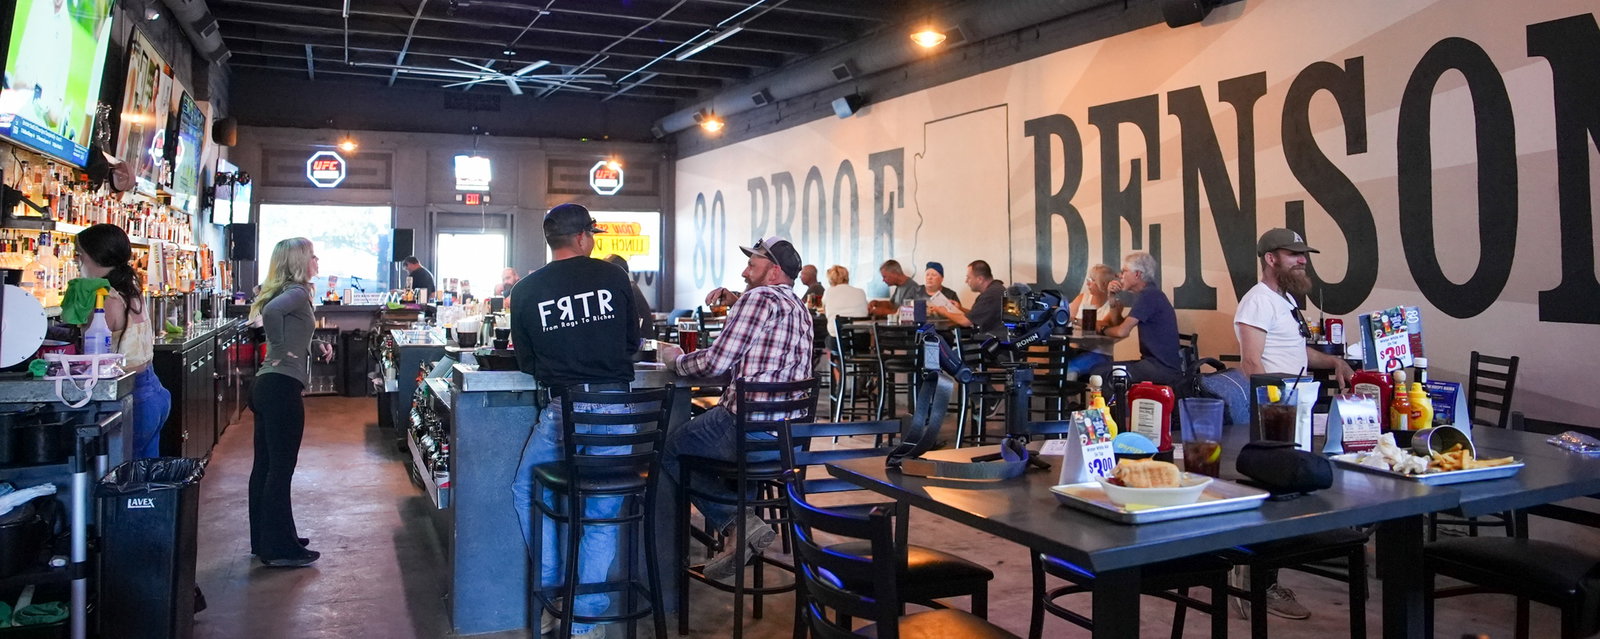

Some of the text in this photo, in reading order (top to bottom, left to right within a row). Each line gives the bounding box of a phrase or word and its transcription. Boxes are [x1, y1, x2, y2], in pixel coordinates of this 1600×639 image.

[313, 160, 338, 170] UFC
[595, 169, 618, 179] UFC
[693, 147, 904, 298] 80 PROOF
[1015, 333, 1038, 348] RONIN
[127, 498, 155, 508] LAVEX
